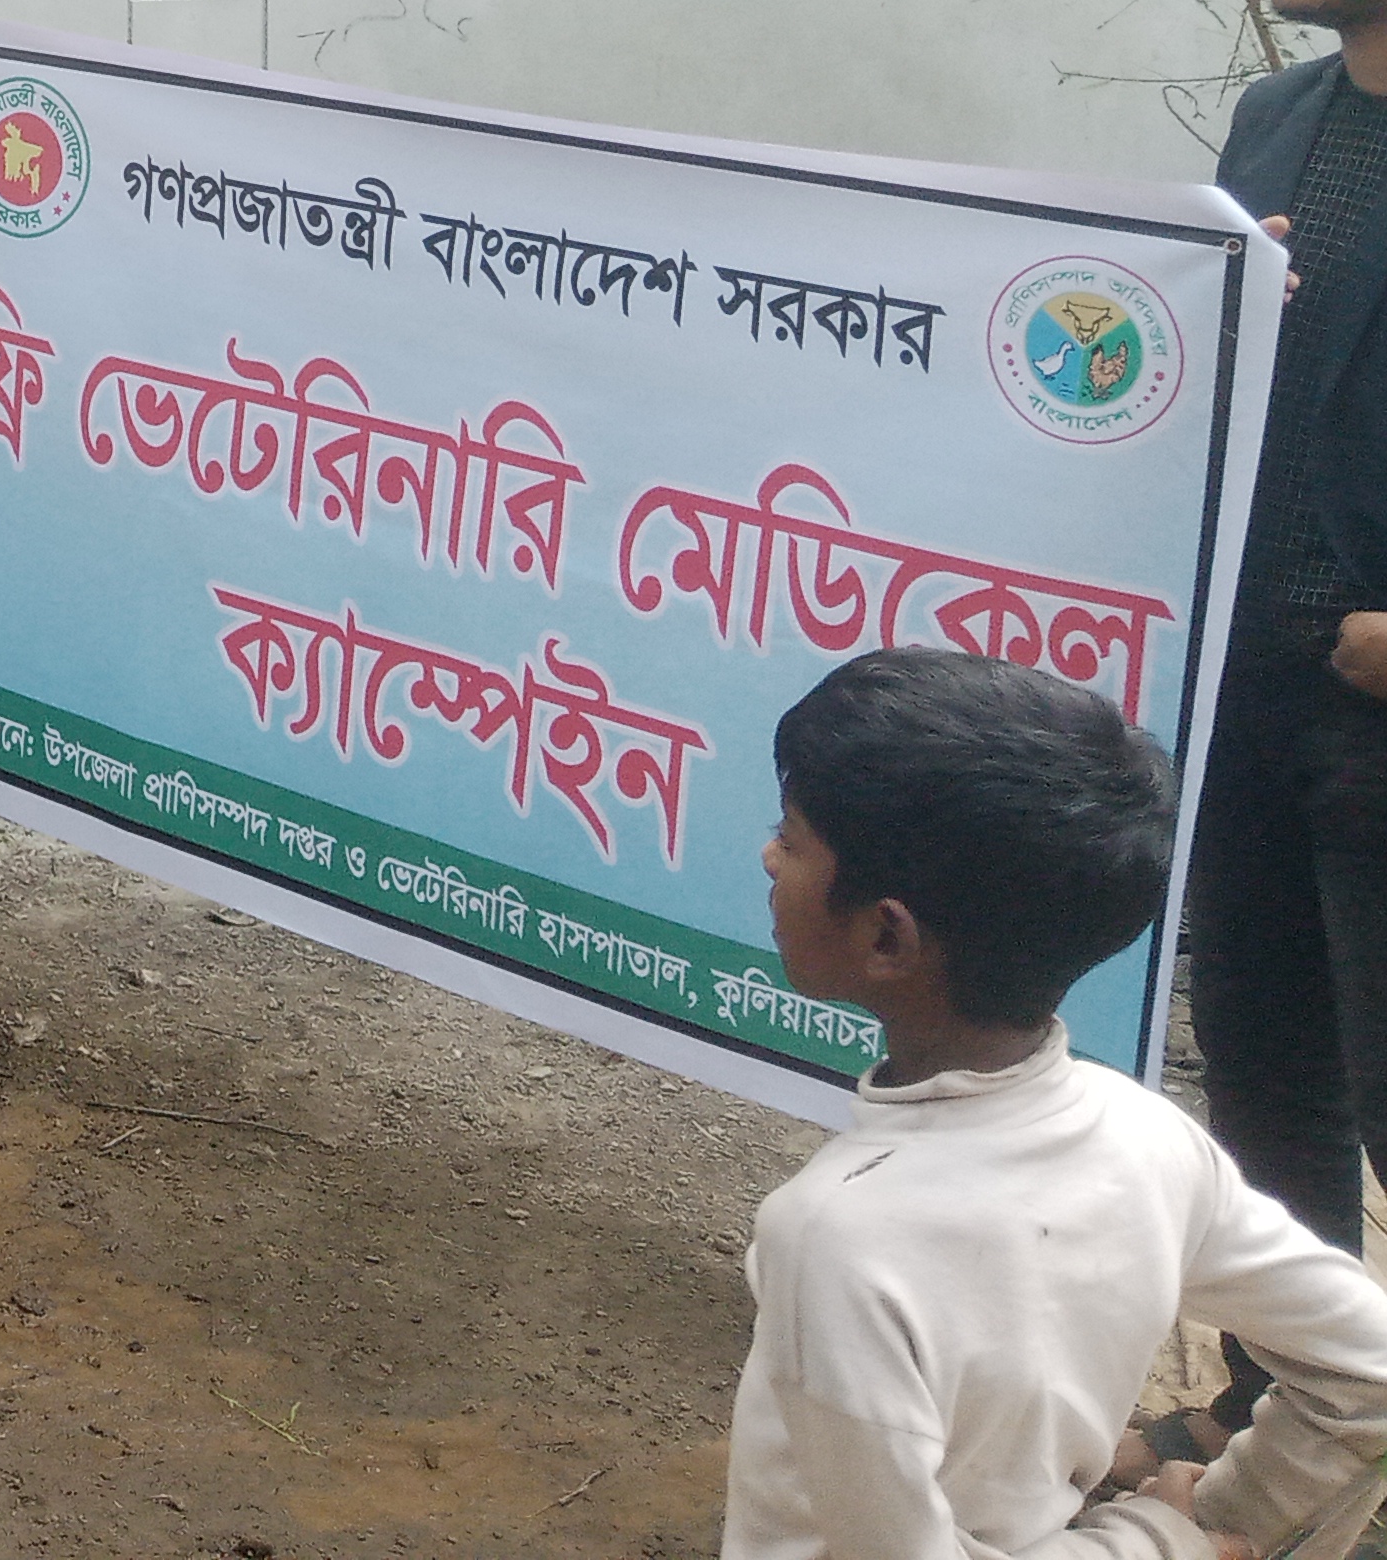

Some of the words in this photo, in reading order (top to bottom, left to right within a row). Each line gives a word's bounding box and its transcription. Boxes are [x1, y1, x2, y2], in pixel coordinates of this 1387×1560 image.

[40, 95, 82, 181] বাংলাদেশ
[122, 155, 406, 271] গণপ্রজাতন্ত্রী
[421, 213, 697, 327] বাংলাদেশ
[715, 265, 946, 373] সরকার
[80, 337, 587, 591] ভেটেরিনারি
[619, 463, 1176, 725] মেডিকেল
[1028, 390, 1133, 430] বাংলাদেশ
[213, 587, 708, 862] ক্যাম্পেইন
[43, 723, 137, 800] উপজেলা
[143, 770, 273, 846] প্রাণিসম্পদ
[278, 817, 337, 870] দপ্তর
[345, 844, 366, 878] ও
[378, 857, 529, 938] ভেটেরিনারি
[536, 908, 697, 1009] হাসপাতাল,
[711, 962, 884, 1058] কুলিয়ারচর
